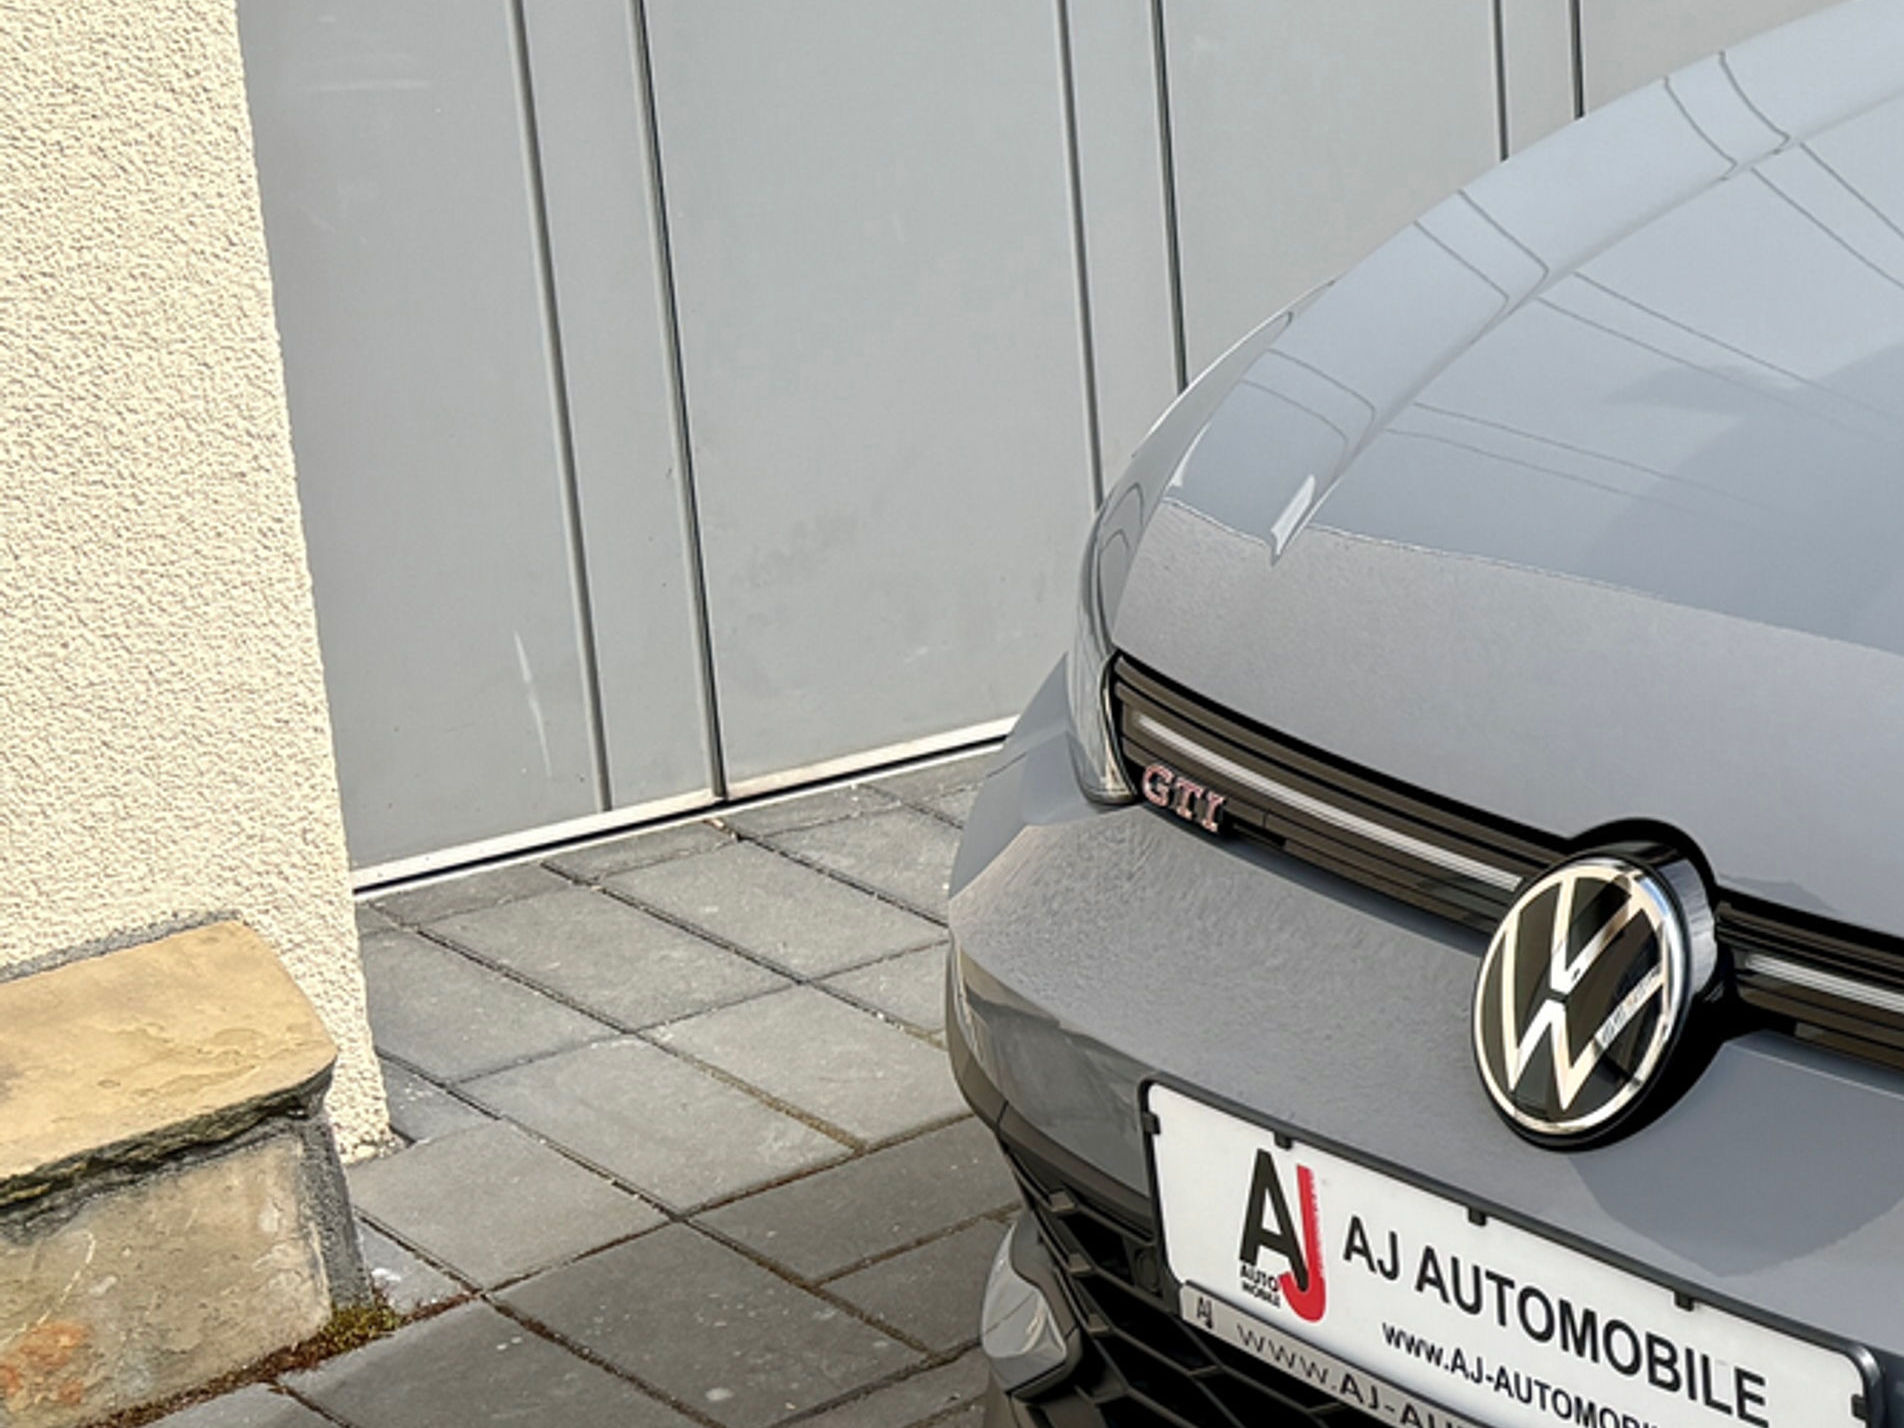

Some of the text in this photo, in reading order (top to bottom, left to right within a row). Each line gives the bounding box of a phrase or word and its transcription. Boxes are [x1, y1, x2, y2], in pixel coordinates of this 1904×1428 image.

[1142, 765, 1226, 834] GTI
[1492, 866, 1674, 1118] VW
[1239, 1148, 1326, 1322] AJ
[1343, 1215, 1399, 1280] AJ
[1240, 1263, 1280, 1292] AUTO
[1241, 1281, 1281, 1308] MOBILE
